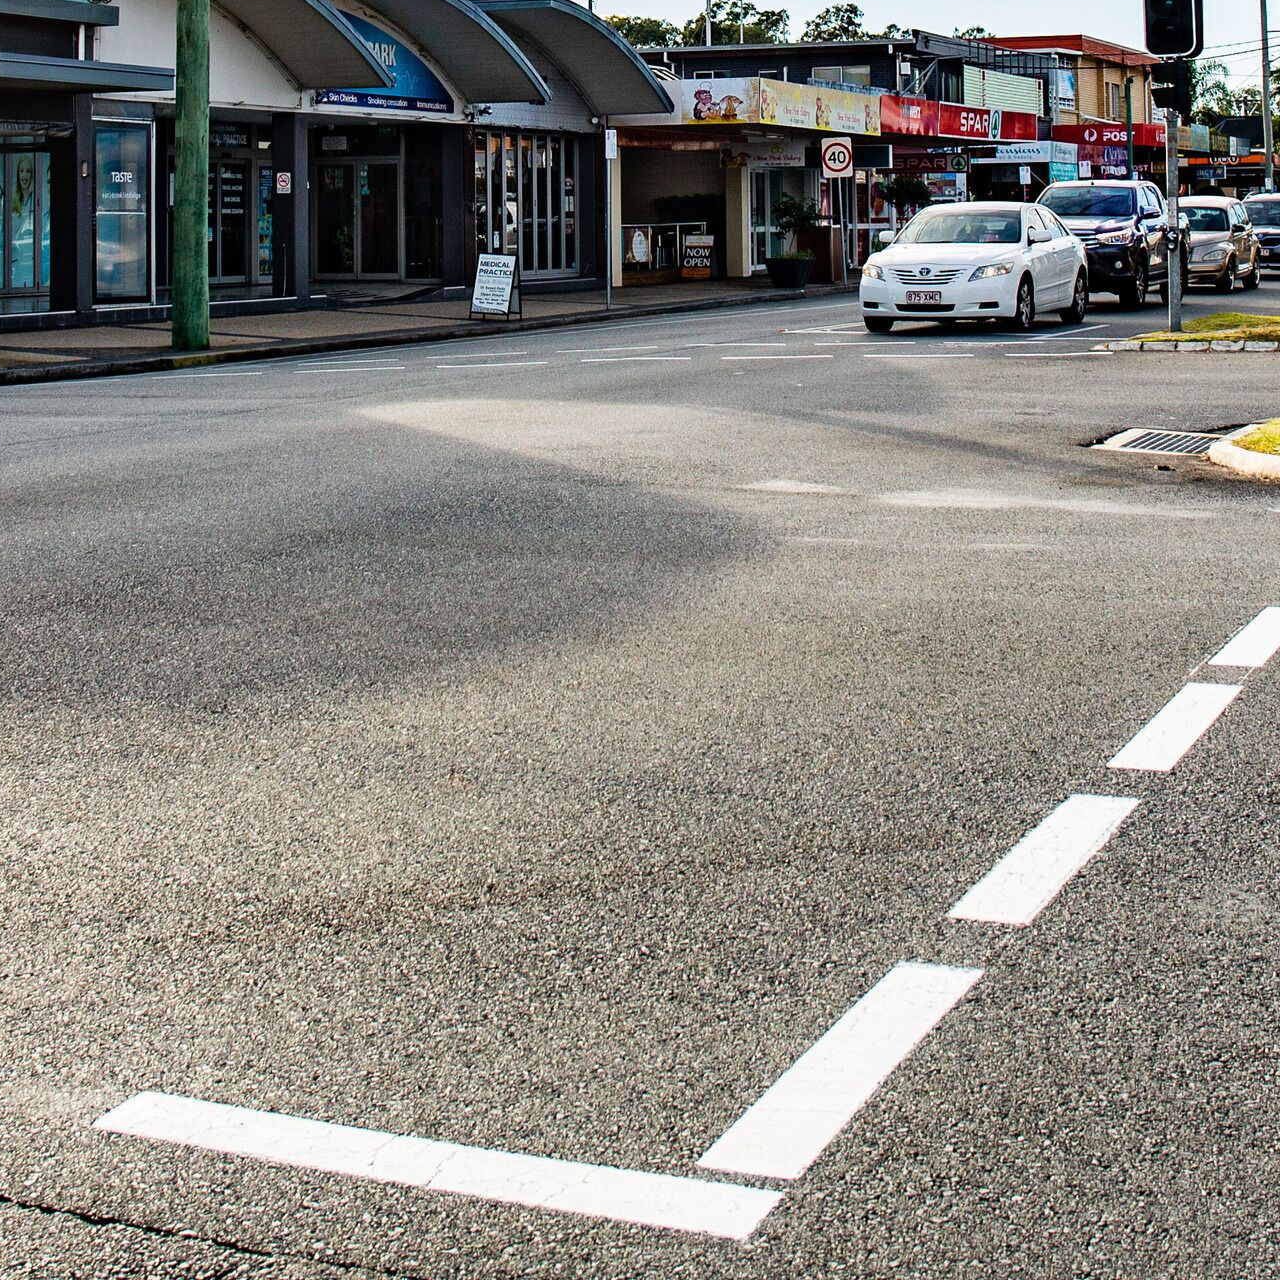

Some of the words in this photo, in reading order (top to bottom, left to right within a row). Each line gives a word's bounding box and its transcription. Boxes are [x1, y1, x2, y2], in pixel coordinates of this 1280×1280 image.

[328, 92, 340, 101] Skin
[340, 93, 358, 103] Checks
[367, 96, 387, 107] Smoking
[387, 98, 408, 107] cessation
[416, 100, 447, 110] Immunisations
[959, 111, 989, 133] SPAR
[1102, 131, 1135, 141] POS
[828, 150, 847, 164] 40
[893, 157, 946, 169] SPAR
[686, 248, 711, 257] NOW
[684, 258, 711, 267] OPEN
[907, 293, 921, 302] 875
